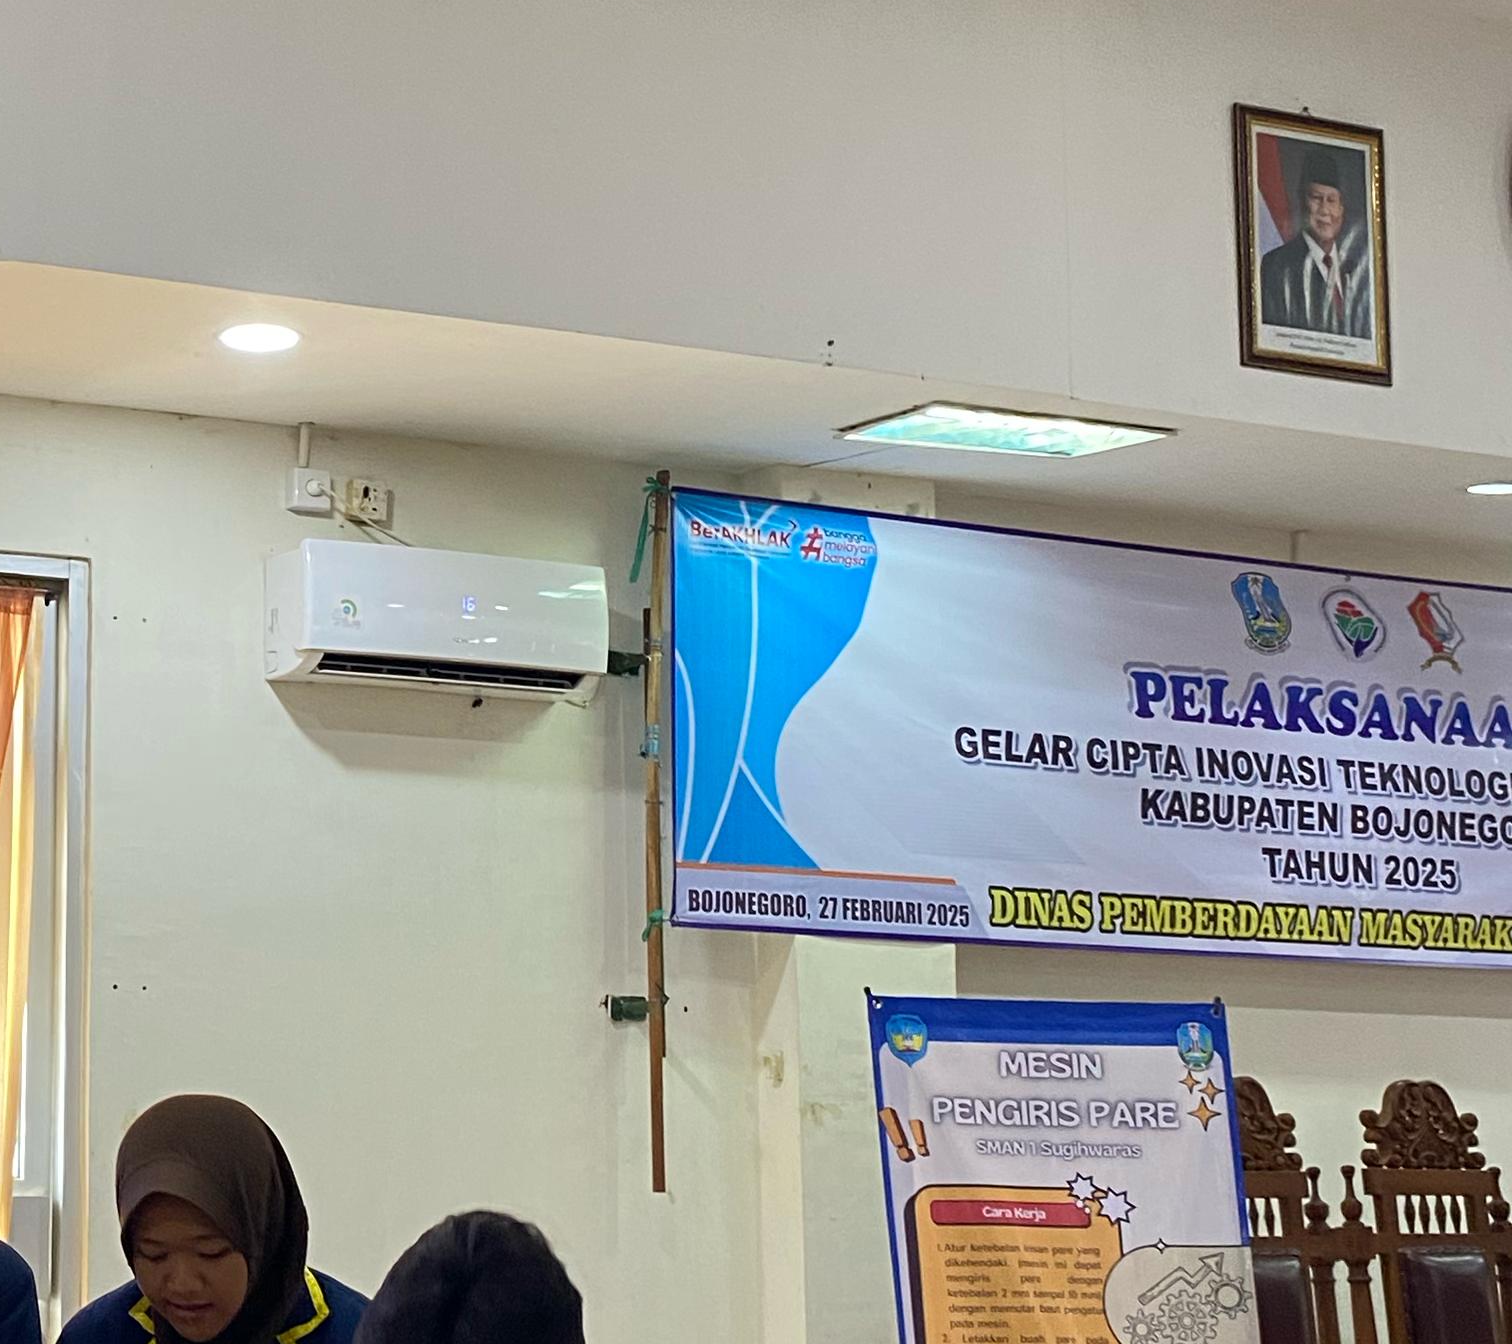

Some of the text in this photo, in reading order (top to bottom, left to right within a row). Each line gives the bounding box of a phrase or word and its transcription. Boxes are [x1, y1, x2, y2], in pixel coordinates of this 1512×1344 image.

[823, 551, 867, 567] bangsa
[954, 726, 1512, 801] GELAR CIPTA INOVASI TEKNOLOG
[1140, 788, 1340, 834] KABUPATEN
[1262, 848, 1458, 890] TAHUN 2025
[688, 889, 969, 927] BOJONEGORO, 27 FEBRUARI 2025
[988, 885, 1092, 931] DINAS
[1100, 893, 1352, 945] PEMBERDAYAAN
[999, 1051, 1103, 1080] MESIN
[932, 1097, 1180, 1128] PENGIRIS PARE
[976, 1140, 1026, 1155] SMAN
[1040, 1142, 1142, 1160] Sugihwaras
[982, 1206, 1046, 1222] Cara Kerja
[1076, 1247, 1100, 1257] yang
[1073, 1261, 1102, 1270] dapat
[1067, 1276, 1103, 1286] dengan
[947, 1289, 997, 1297] ketebalan
[948, 1305, 986, 1315] dengan
[950, 1320, 974, 1330] pada
[962, 1335, 1009, 1343] Letakkan
